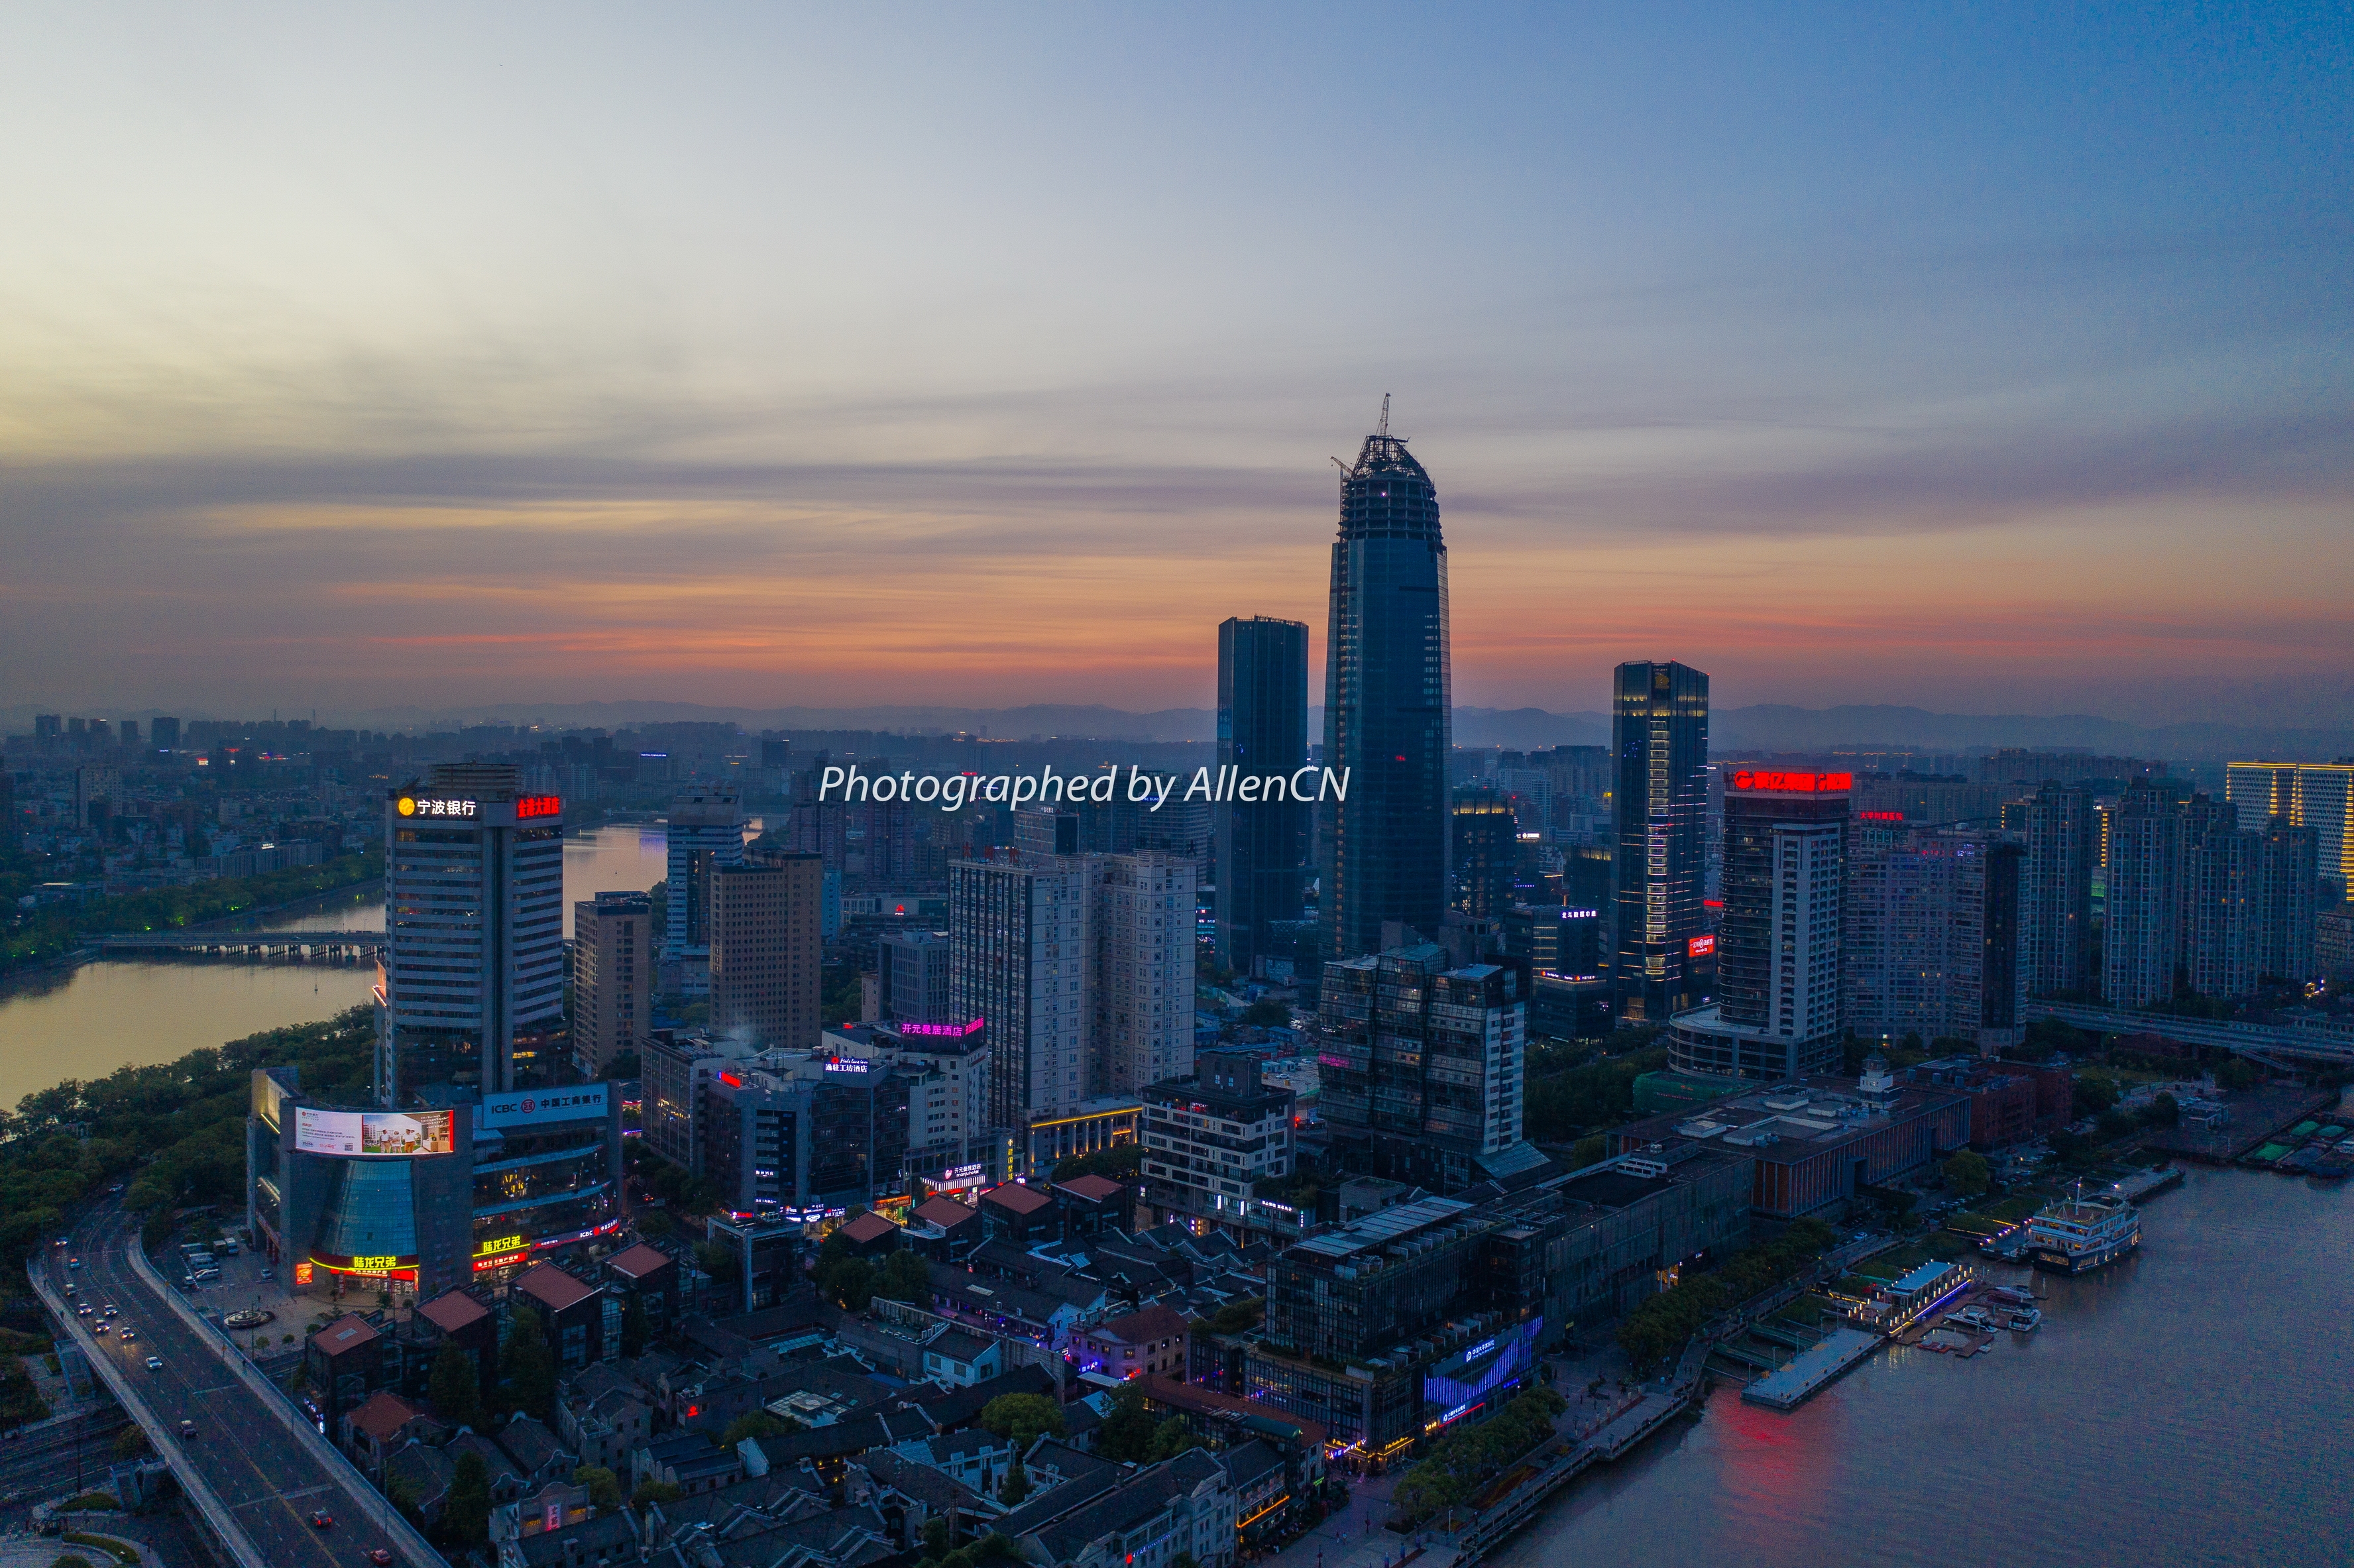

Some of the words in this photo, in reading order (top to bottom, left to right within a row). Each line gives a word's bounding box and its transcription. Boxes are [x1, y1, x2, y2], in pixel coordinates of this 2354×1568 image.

[417, 799, 476, 816] 宁波银行
[518, 797, 560, 818] 金港大酒店
[902, 1023, 963, 1036] 开元曼居酒店
[825, 1063, 868, 1073] 逸驻工坊酒店
[541, 1094, 602, 1109] 中国工商银行
[491, 1103, 518, 1114] ICBC
[954, 1163, 981, 1174] 开元曼居酒店
[483, 1235, 521, 1253] 陆龙兄弟
[354, 1256, 396, 1268] 陆龙兄弟
